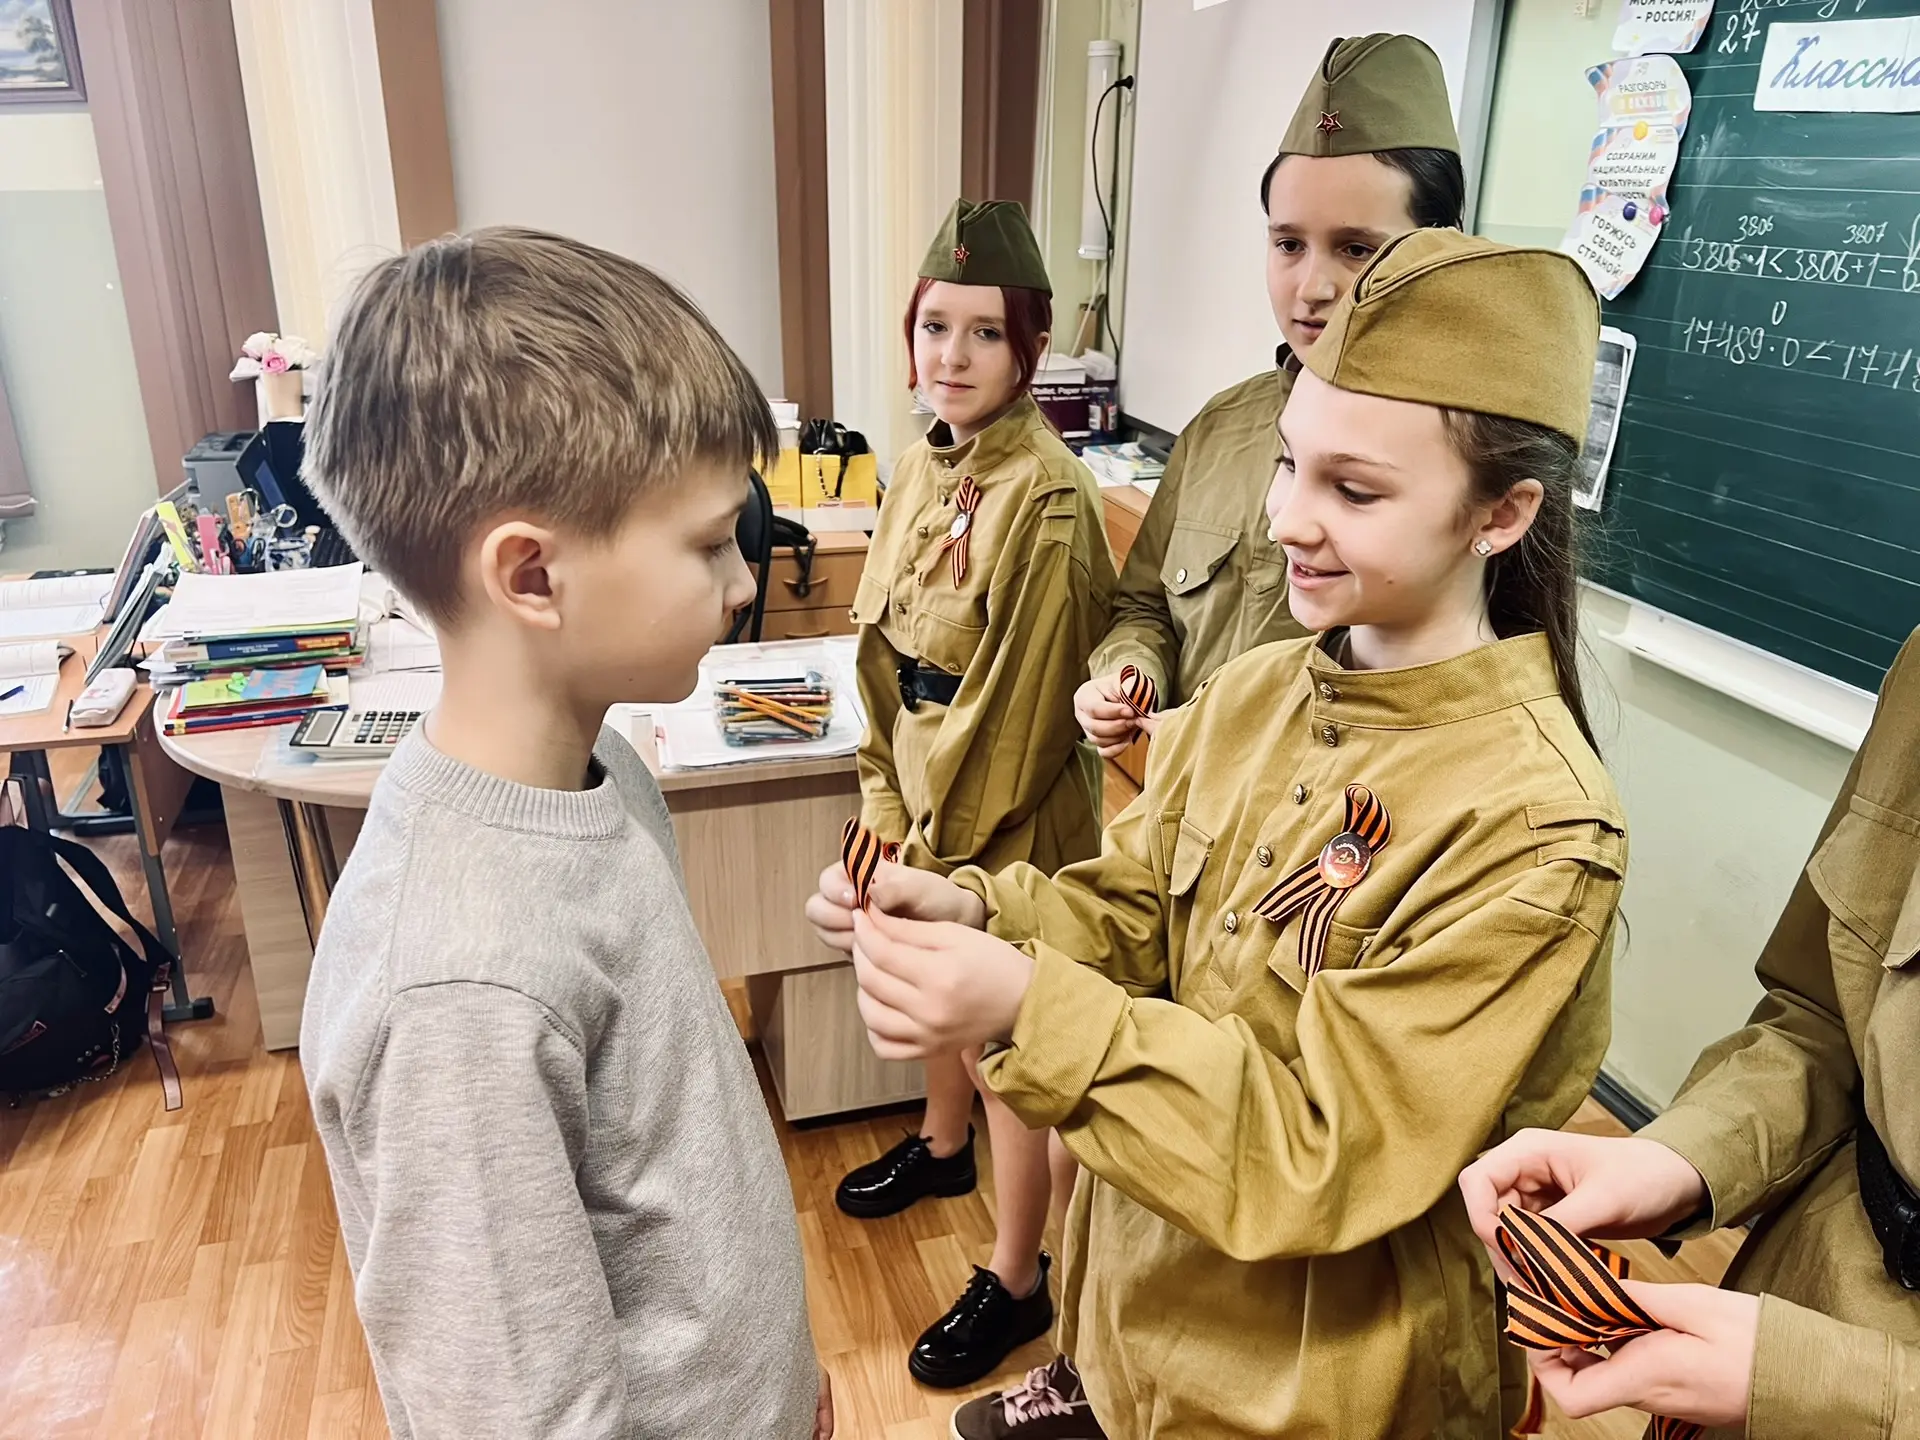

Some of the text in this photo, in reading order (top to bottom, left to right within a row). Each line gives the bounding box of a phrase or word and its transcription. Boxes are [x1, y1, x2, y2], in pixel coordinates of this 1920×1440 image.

[1717, 11, 1761, 54] 27
[1618, 80, 1667, 93] РАЗГОВОРЫ
[1606, 151, 1656, 161] СОХРАНИМ
[1593, 165, 1667, 175] НАЦИОНАЛЬНЫЕ
[1599, 179, 1652, 188] КУЛЬТУРНЫЕ
[1592, 215, 1636, 249] ГОРЖУСЬ
[1732, 215, 1774, 243] 3806
[1842, 221, 1888, 244] 3807
[1592, 234, 1625, 260] СВОЕЙ
